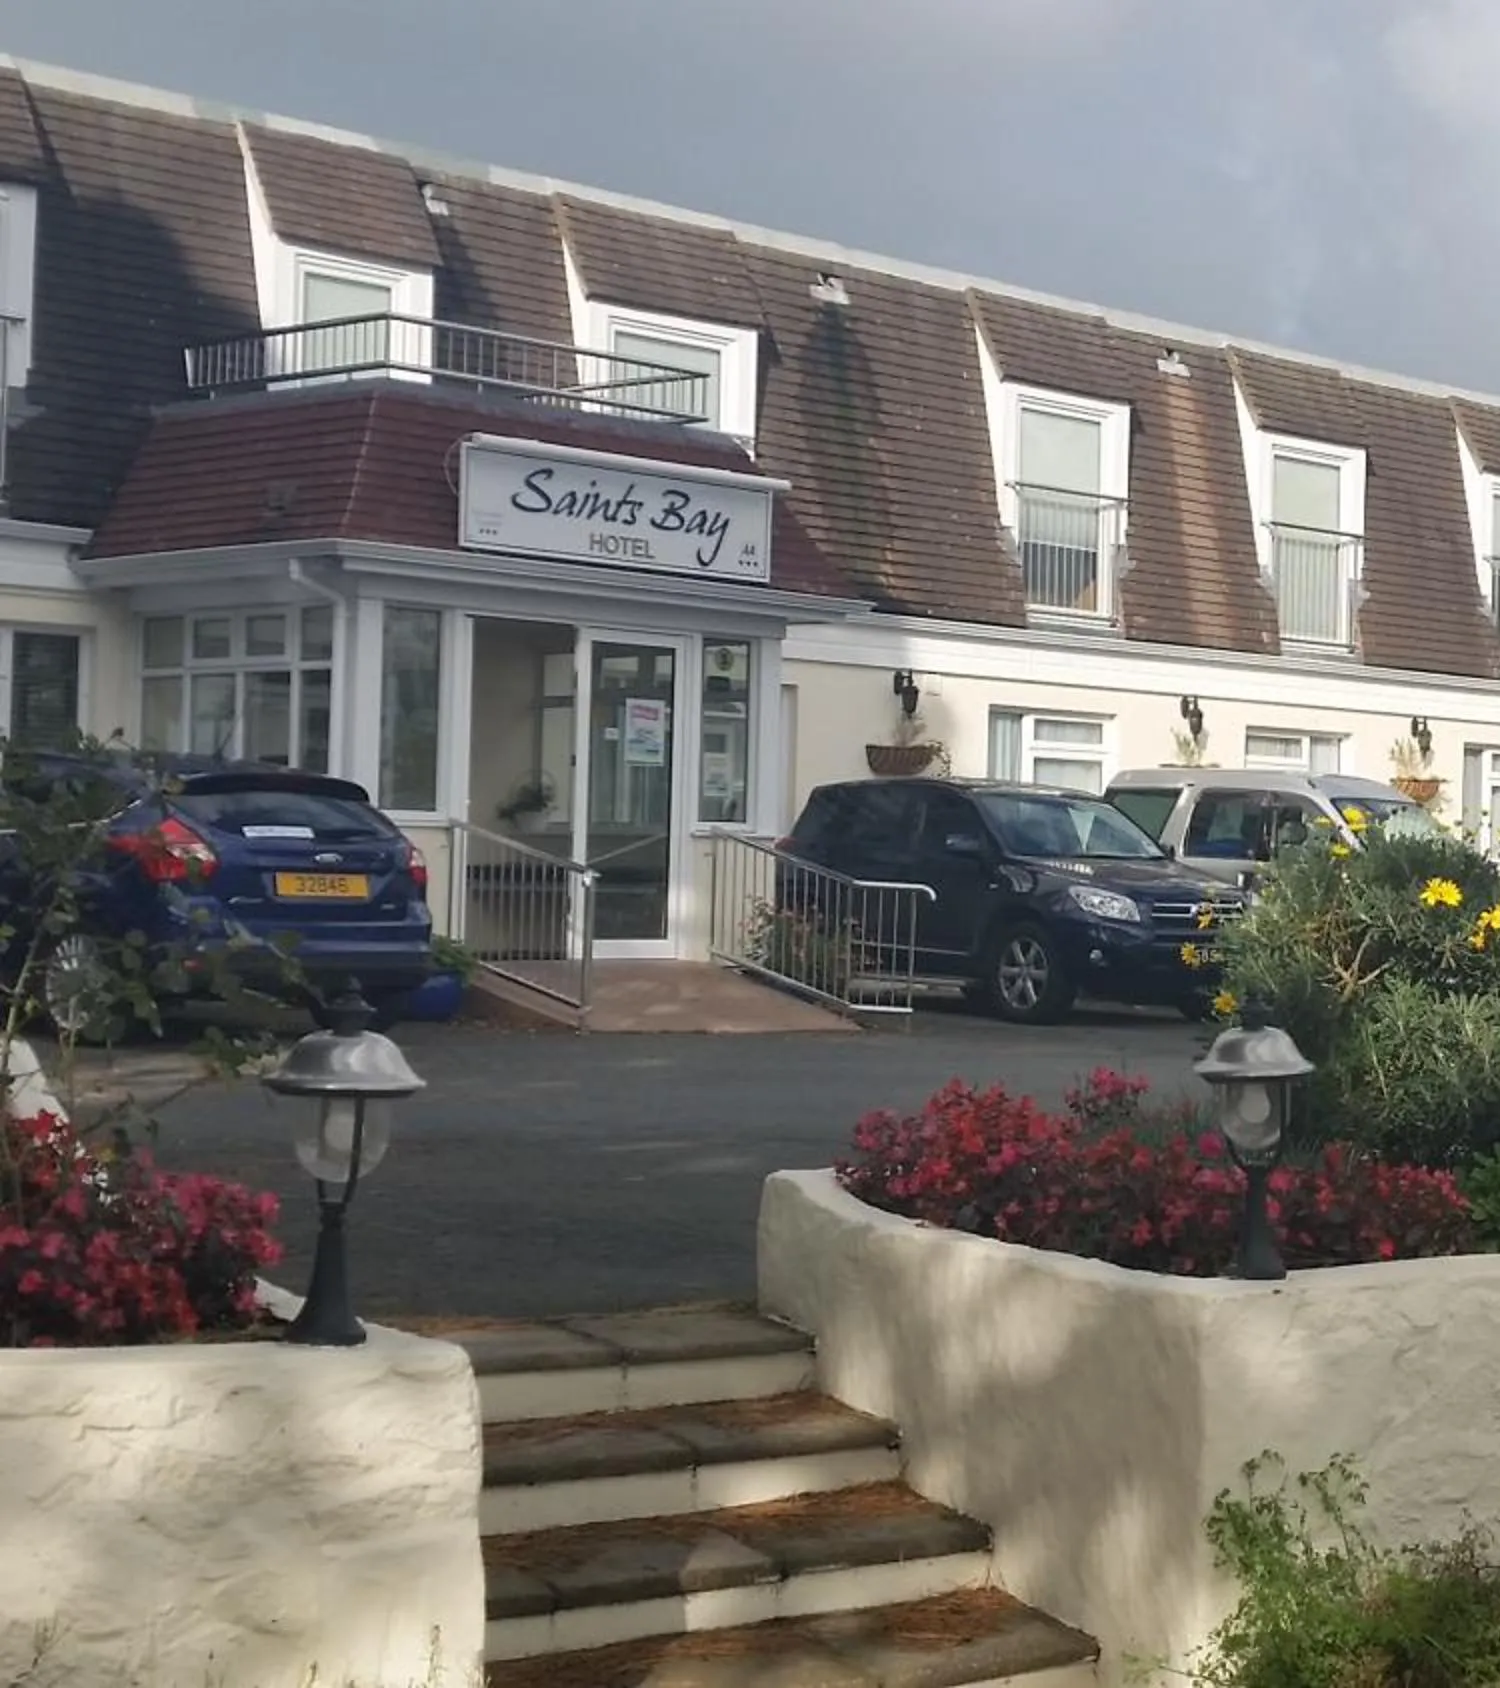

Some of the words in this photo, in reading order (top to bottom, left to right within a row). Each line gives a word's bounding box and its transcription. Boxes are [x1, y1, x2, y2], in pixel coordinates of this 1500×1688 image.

[509, 467, 644, 526] Saints
[650, 489, 731, 567] Bay
[589, 532, 656, 560] HOTEL
